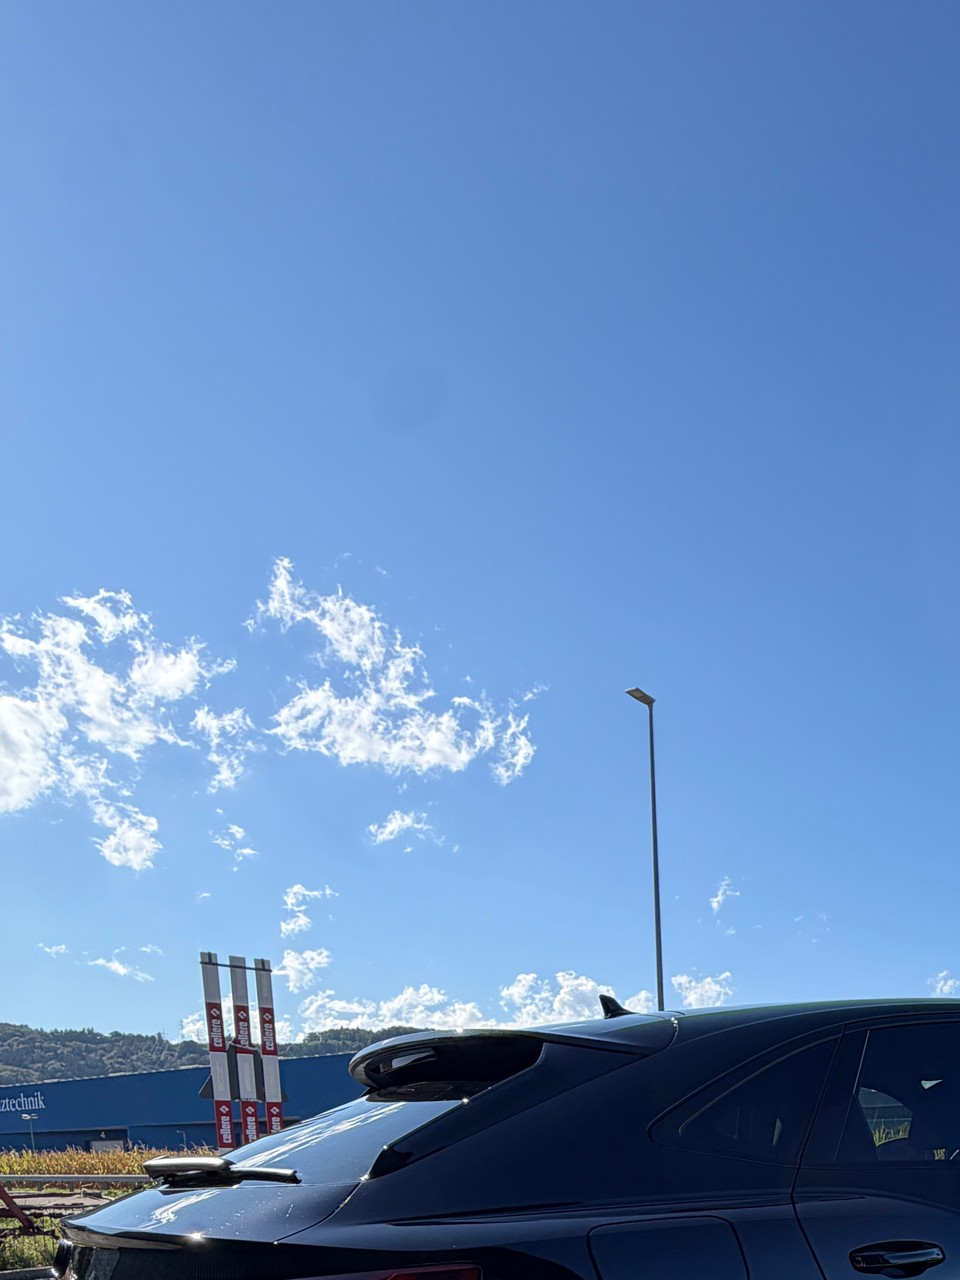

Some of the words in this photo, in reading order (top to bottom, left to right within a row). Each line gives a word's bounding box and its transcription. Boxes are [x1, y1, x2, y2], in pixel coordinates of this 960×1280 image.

[211, 1018, 223, 1048] cellere
[237, 1021, 249, 1047] ellere
[263, 1023, 275, 1051] cellere
[0, 1091, 46, 1112] ztechnik
[220, 1115, 232, 1144] cellere
[245, 1116, 257, 1142] ellere
